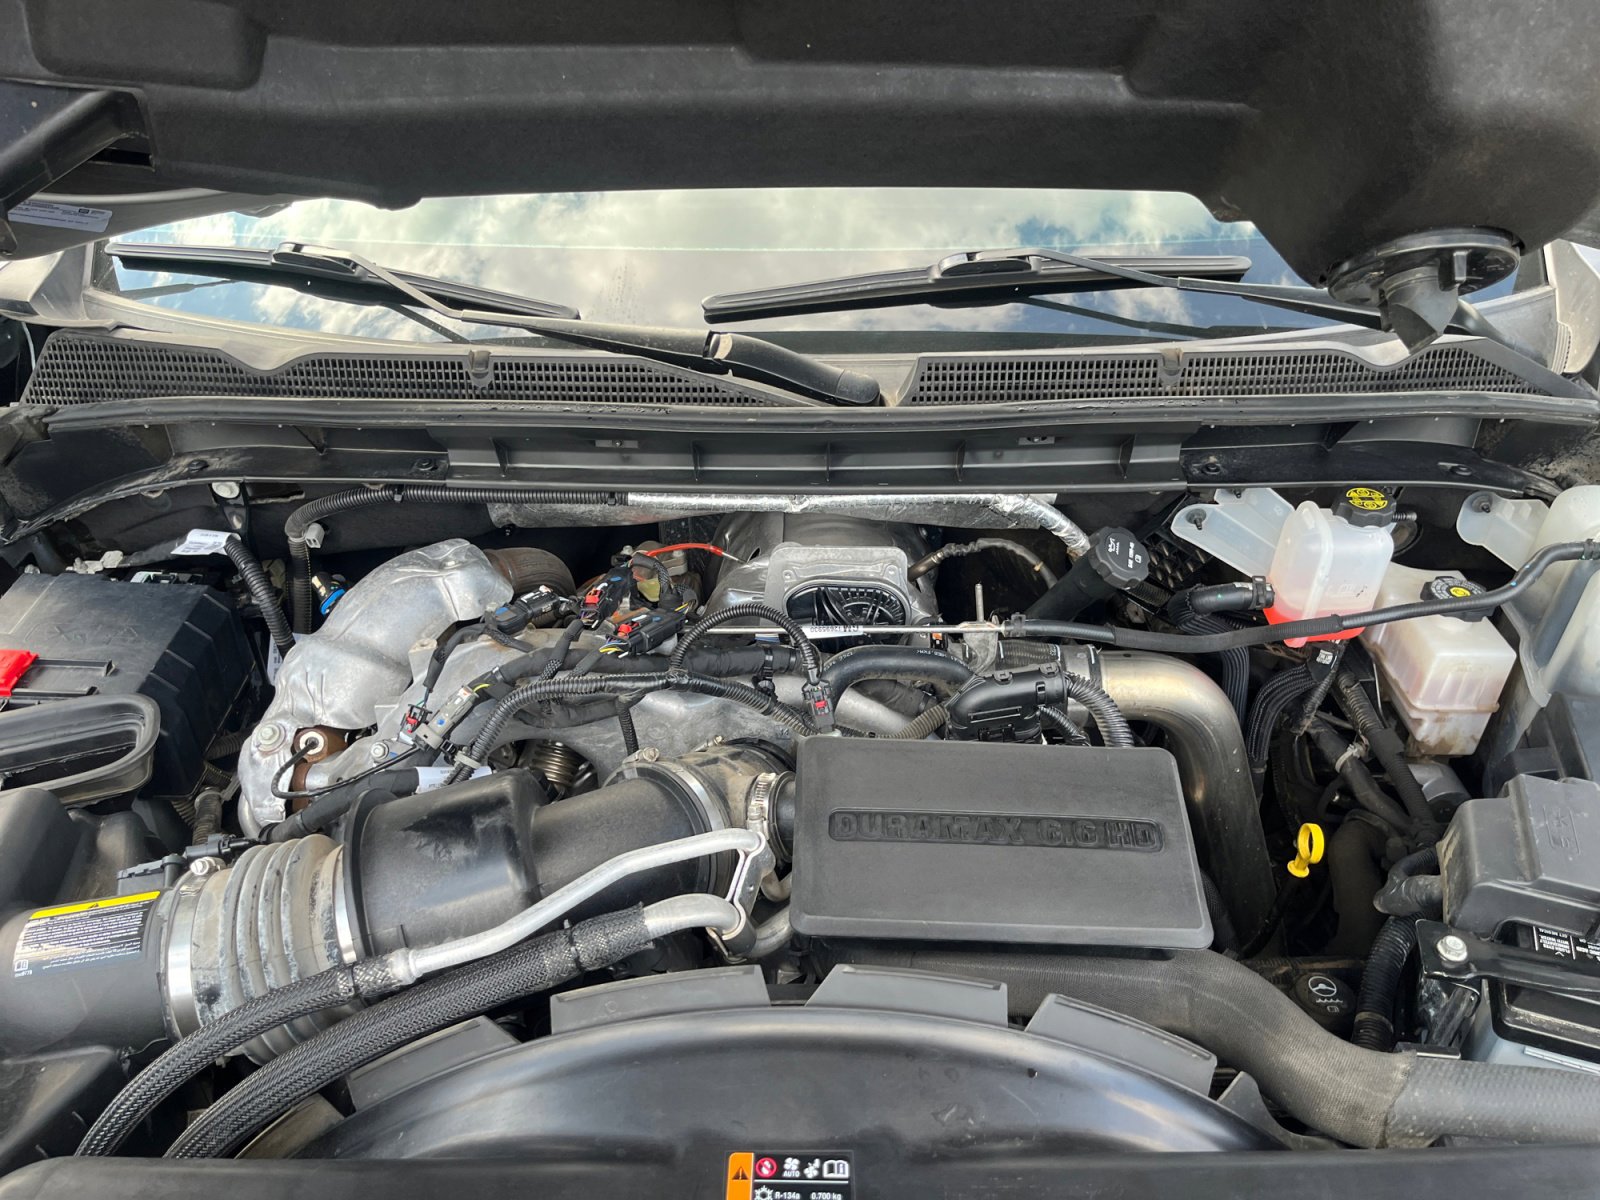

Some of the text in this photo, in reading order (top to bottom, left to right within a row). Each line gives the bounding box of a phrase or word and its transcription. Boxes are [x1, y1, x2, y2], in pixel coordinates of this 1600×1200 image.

[835, 812, 1159, 850] DURAMAX 6.6 HD
[783, 1170, 800, 1178] AUTO
[775, 1192, 800, 1200] R-134a
[811, 1192, 831, 1200] 0.700
